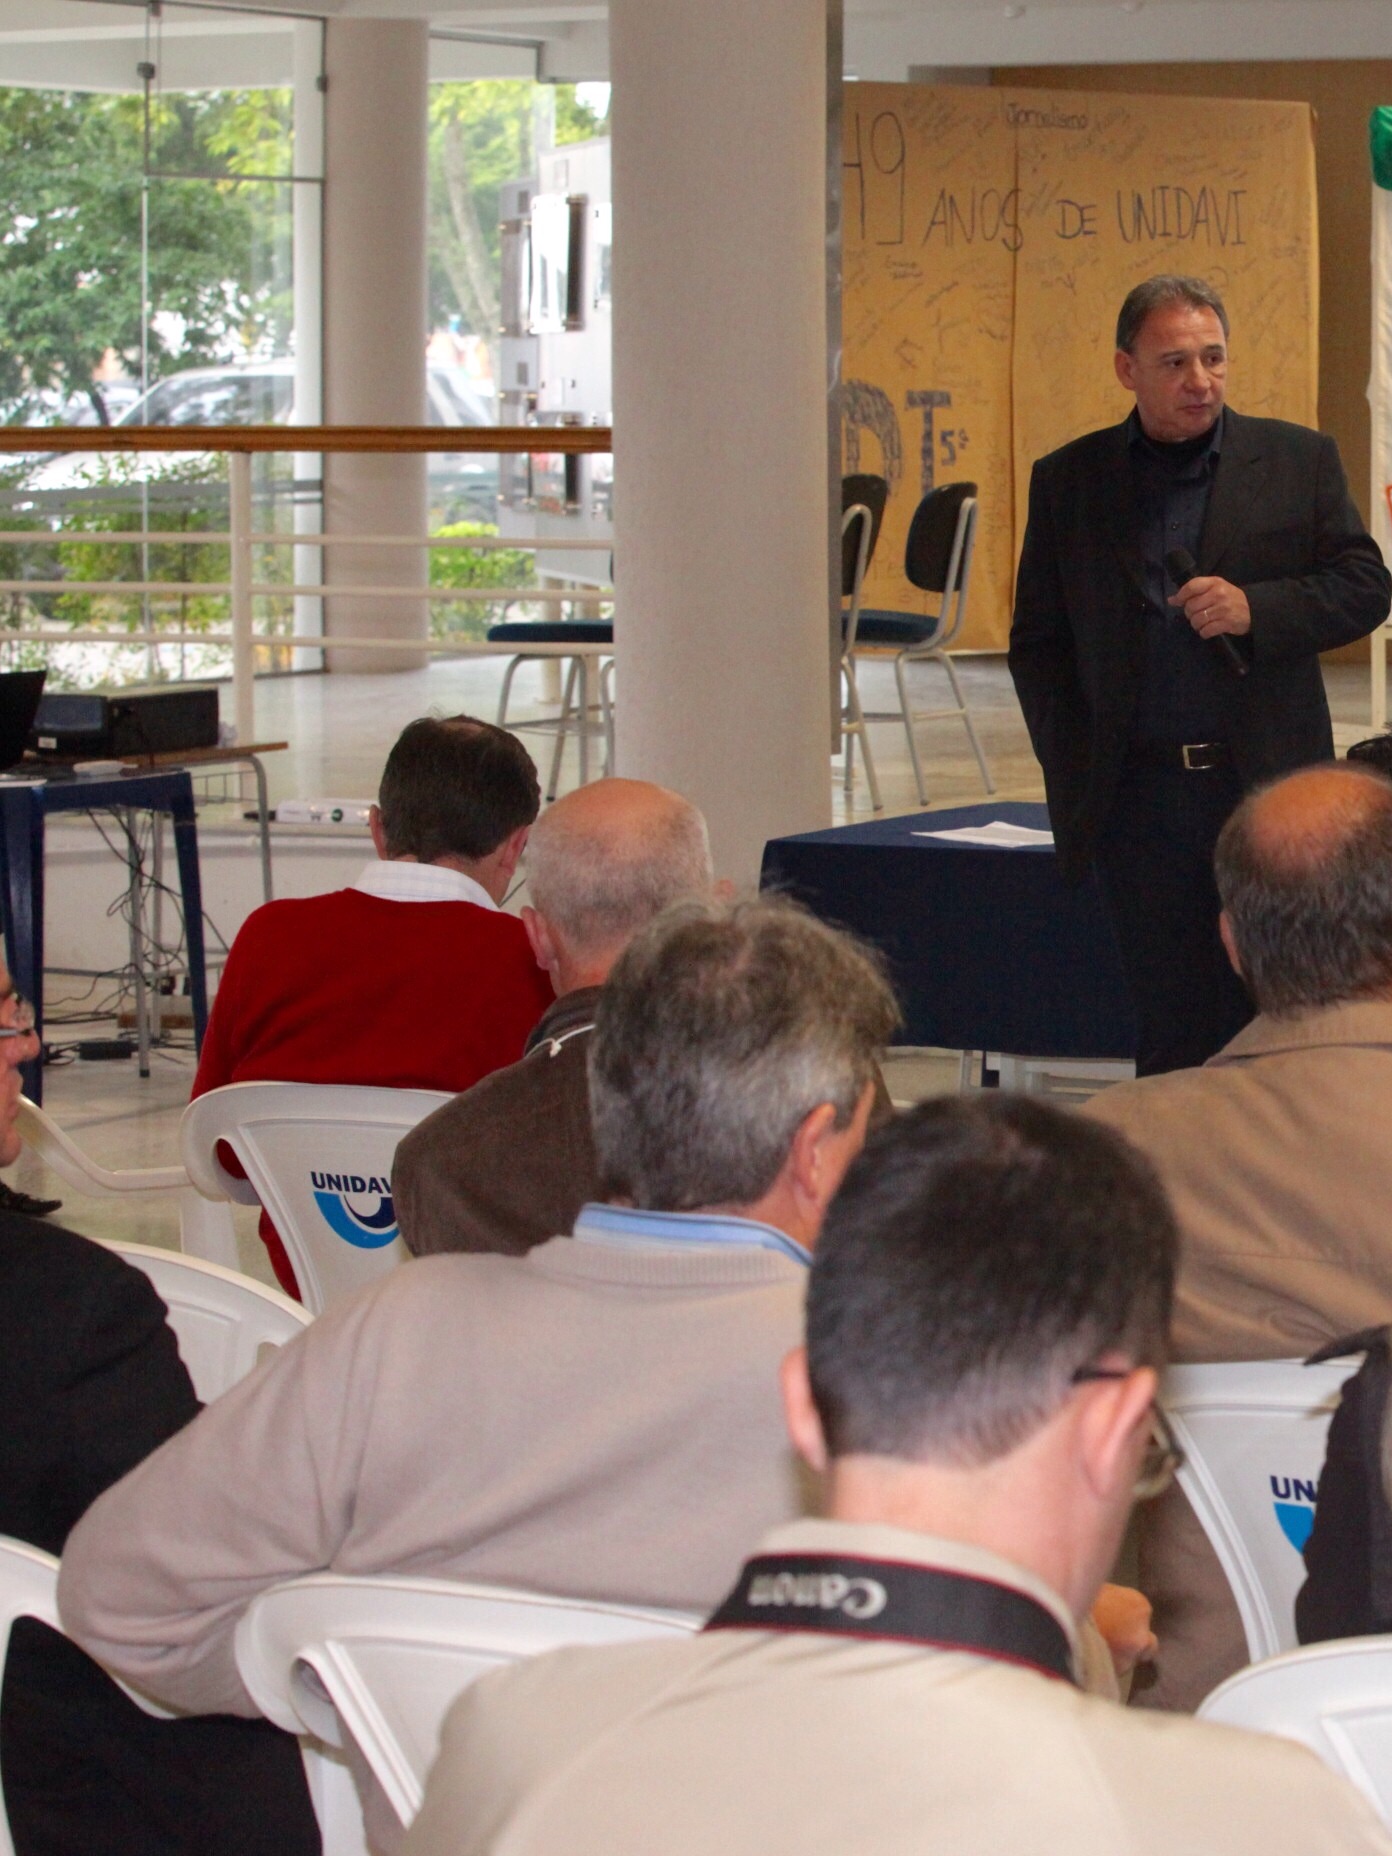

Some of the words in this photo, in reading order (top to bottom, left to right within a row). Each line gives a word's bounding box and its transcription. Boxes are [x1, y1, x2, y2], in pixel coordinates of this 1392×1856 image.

[1006, 103, 1089, 129] Jornalismo
[920, 186, 1024, 253] ANOS
[1055, 199, 1098, 240] DE
[1116, 185, 1248, 247] UNIDAVI
[748, 1572, 888, 1619] Canon
